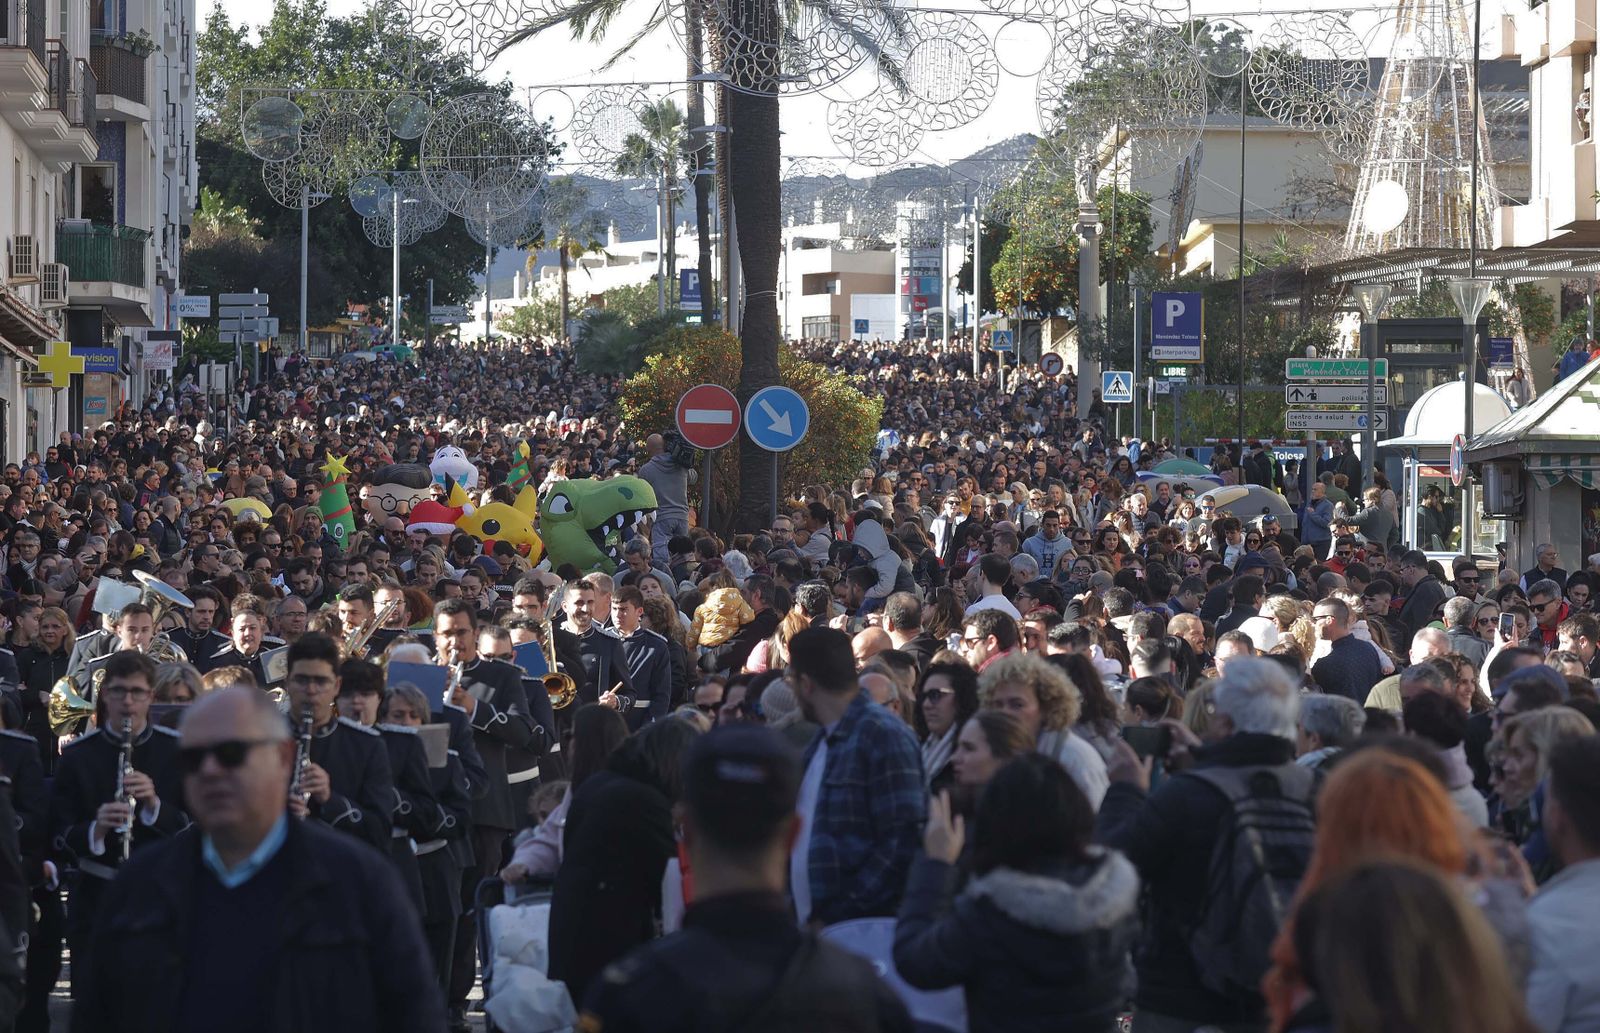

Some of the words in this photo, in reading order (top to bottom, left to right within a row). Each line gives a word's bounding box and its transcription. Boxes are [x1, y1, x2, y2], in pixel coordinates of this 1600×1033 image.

[688, 272, 700, 290] P
[1166, 299, 1185, 327] P
[1163, 367, 1187, 377] LIBRE
[1273, 451, 1305, 461] Tolosa
